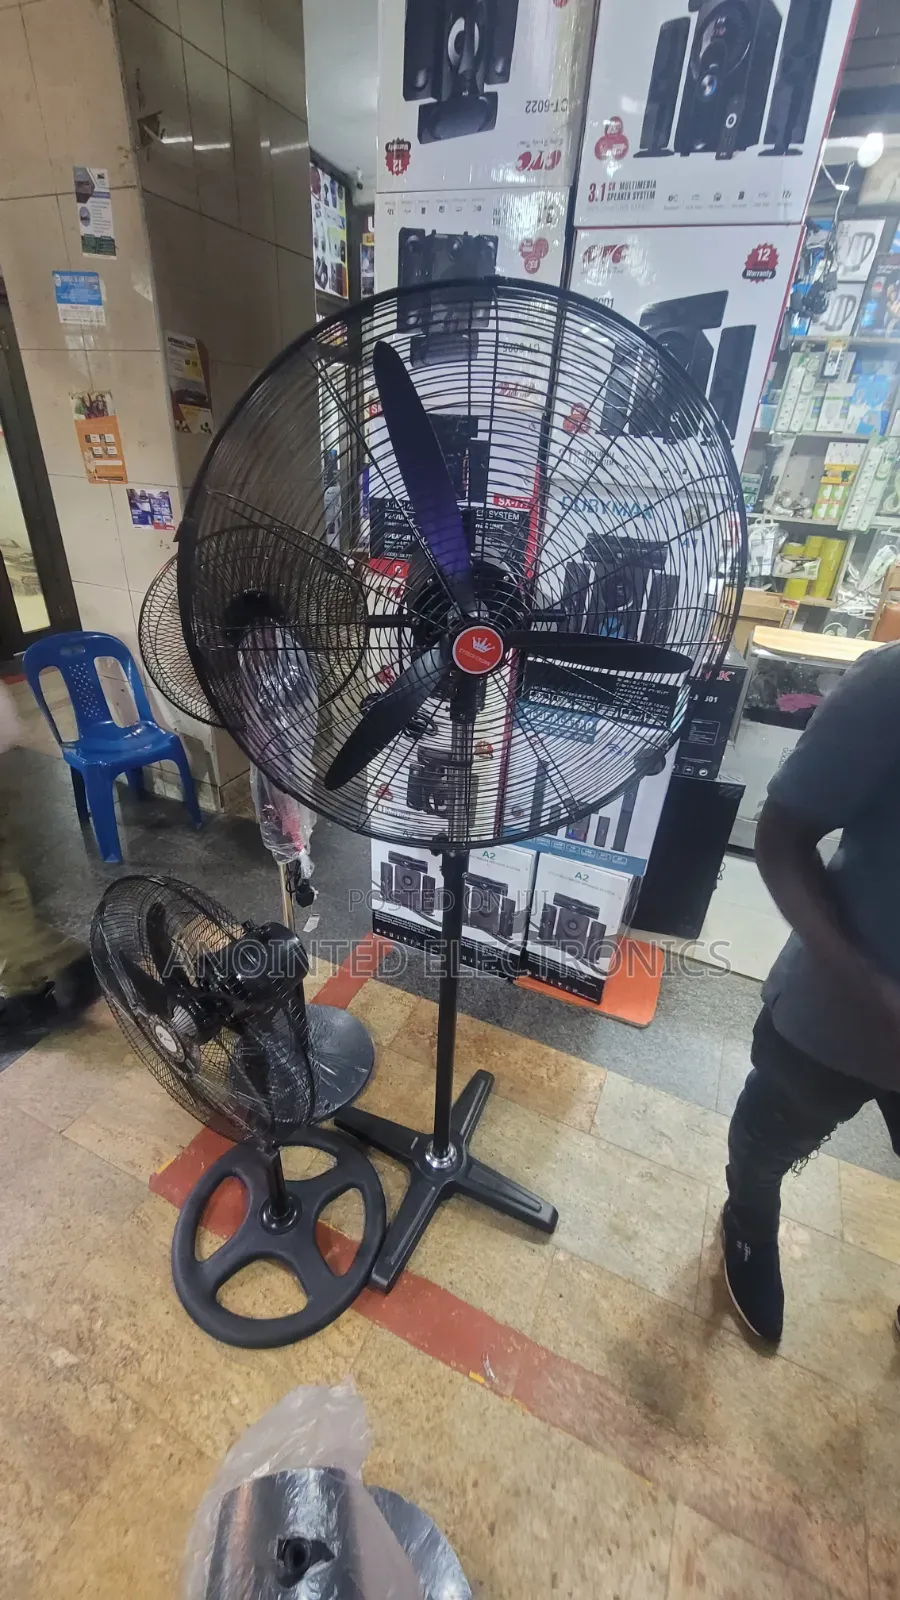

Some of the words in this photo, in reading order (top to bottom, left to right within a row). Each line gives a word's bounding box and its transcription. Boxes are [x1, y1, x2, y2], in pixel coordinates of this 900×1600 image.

[619, 180, 657, 190] MULTIMEDIA
[588, 183, 606, 202] 3.1
[607, 192, 631, 202] SPEAKER
[632, 190, 656, 200] SYSTEM
[757, 248, 770, 261] 12
[746, 269, 773, 279] Warranty
[482, 850, 496, 861] A2
[575, 871, 589, 883] A2
